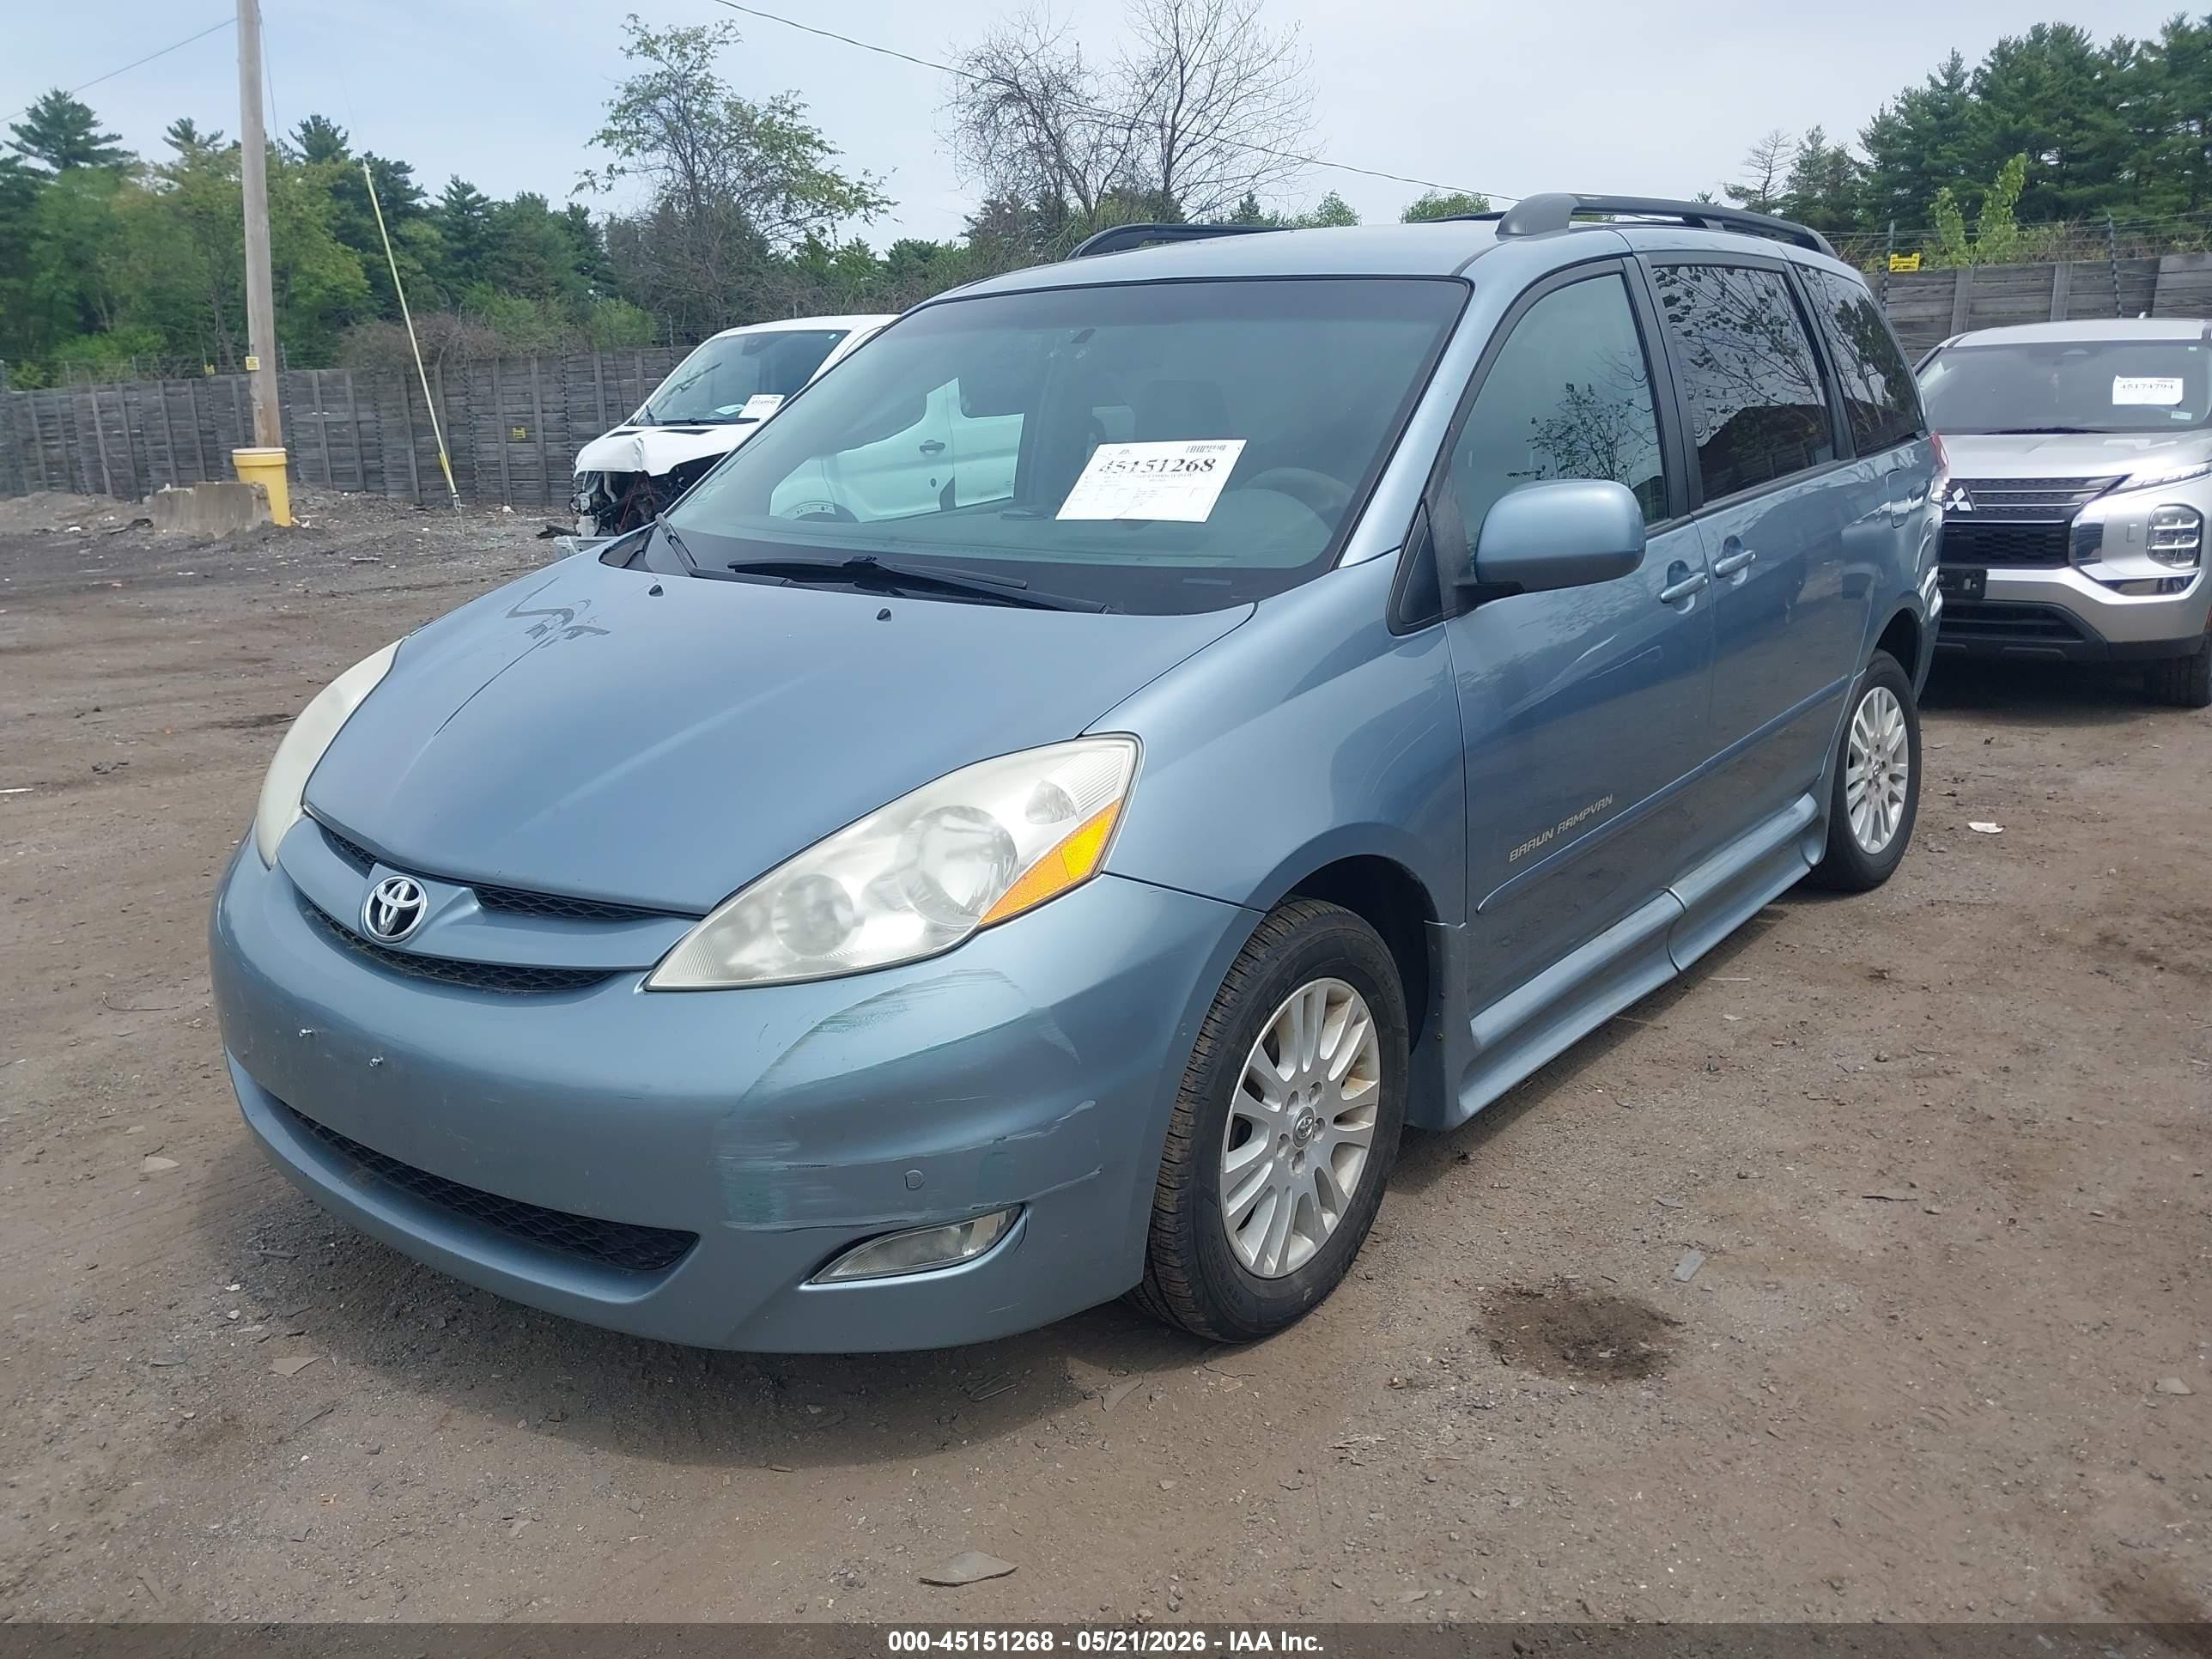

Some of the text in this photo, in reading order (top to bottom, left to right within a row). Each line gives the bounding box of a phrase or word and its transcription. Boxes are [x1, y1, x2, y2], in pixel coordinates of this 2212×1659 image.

[1098, 458, 1217, 474] 45151268
[1510, 793, 1613, 862] BRAUN RAMPVAN
